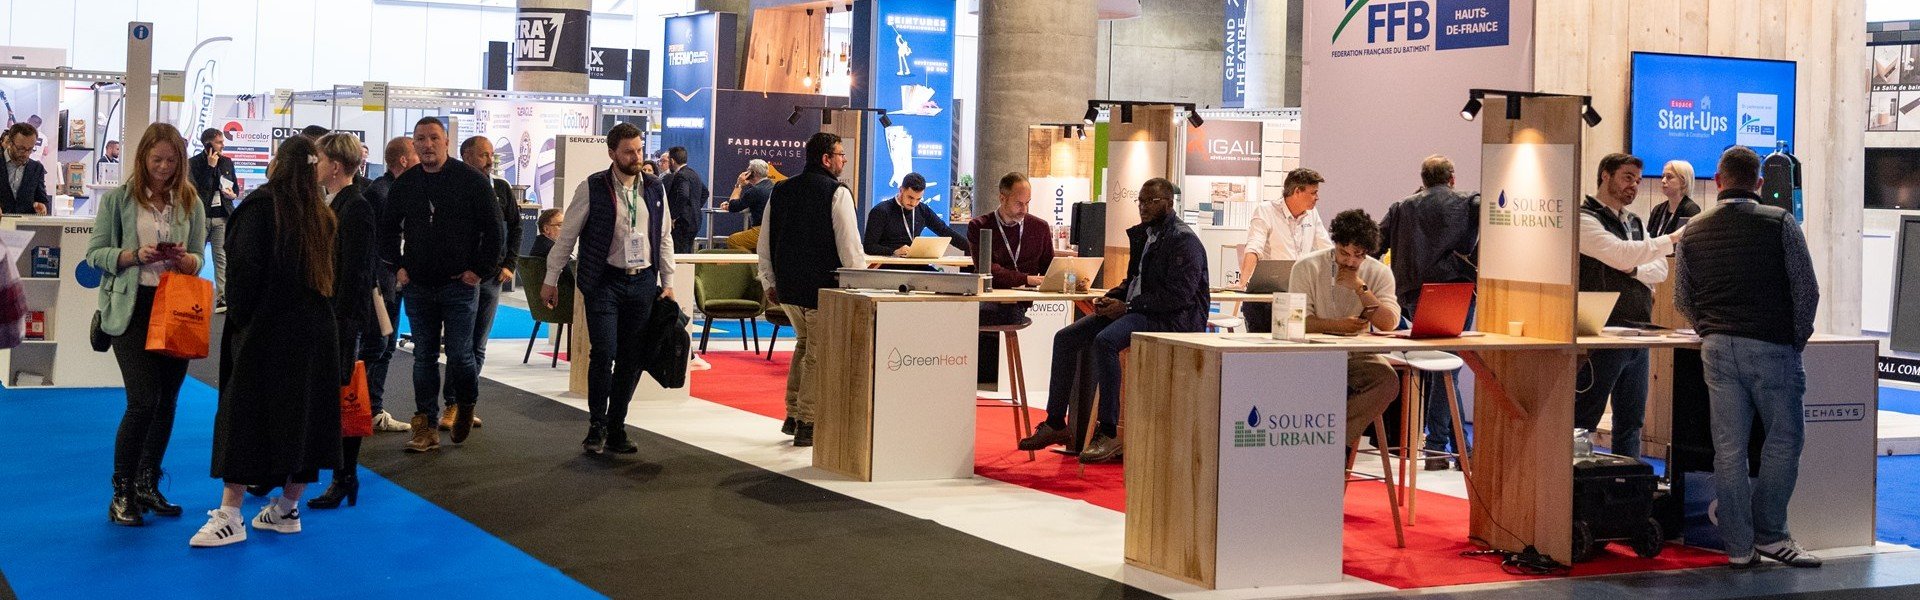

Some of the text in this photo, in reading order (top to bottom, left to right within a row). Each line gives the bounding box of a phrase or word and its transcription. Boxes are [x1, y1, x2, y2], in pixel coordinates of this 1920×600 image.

[1455, 8, 1489, 20] HAUTS-
[1368, 0, 1430, 43] FFB
[1446, 22, 1498, 35] DE-FRANCE
[1226, 18, 1236, 80] GRAND
[1363, 48, 1392, 56] FRANÇAISE
[1236, 17, 1246, 97] THEATRE
[1671, 100, 1693, 108] Espace
[1658, 108, 1728, 135] Start-Ups
[1746, 125, 1760, 133] FFB
[236, 131, 269, 140] Eurocolor
[738, 147, 801, 159] FRANÇAISE
[1513, 198, 1564, 213] SOURCE
[1513, 213, 1564, 228] URBAINE
[1031, 303, 1065, 312] OWECO
[903, 354, 967, 366] GreenHeat
[1804, 408, 1859, 418] ECHASYS
[1269, 413, 1336, 429] SOURCE
[1269, 431, 1336, 446] URBAINE
